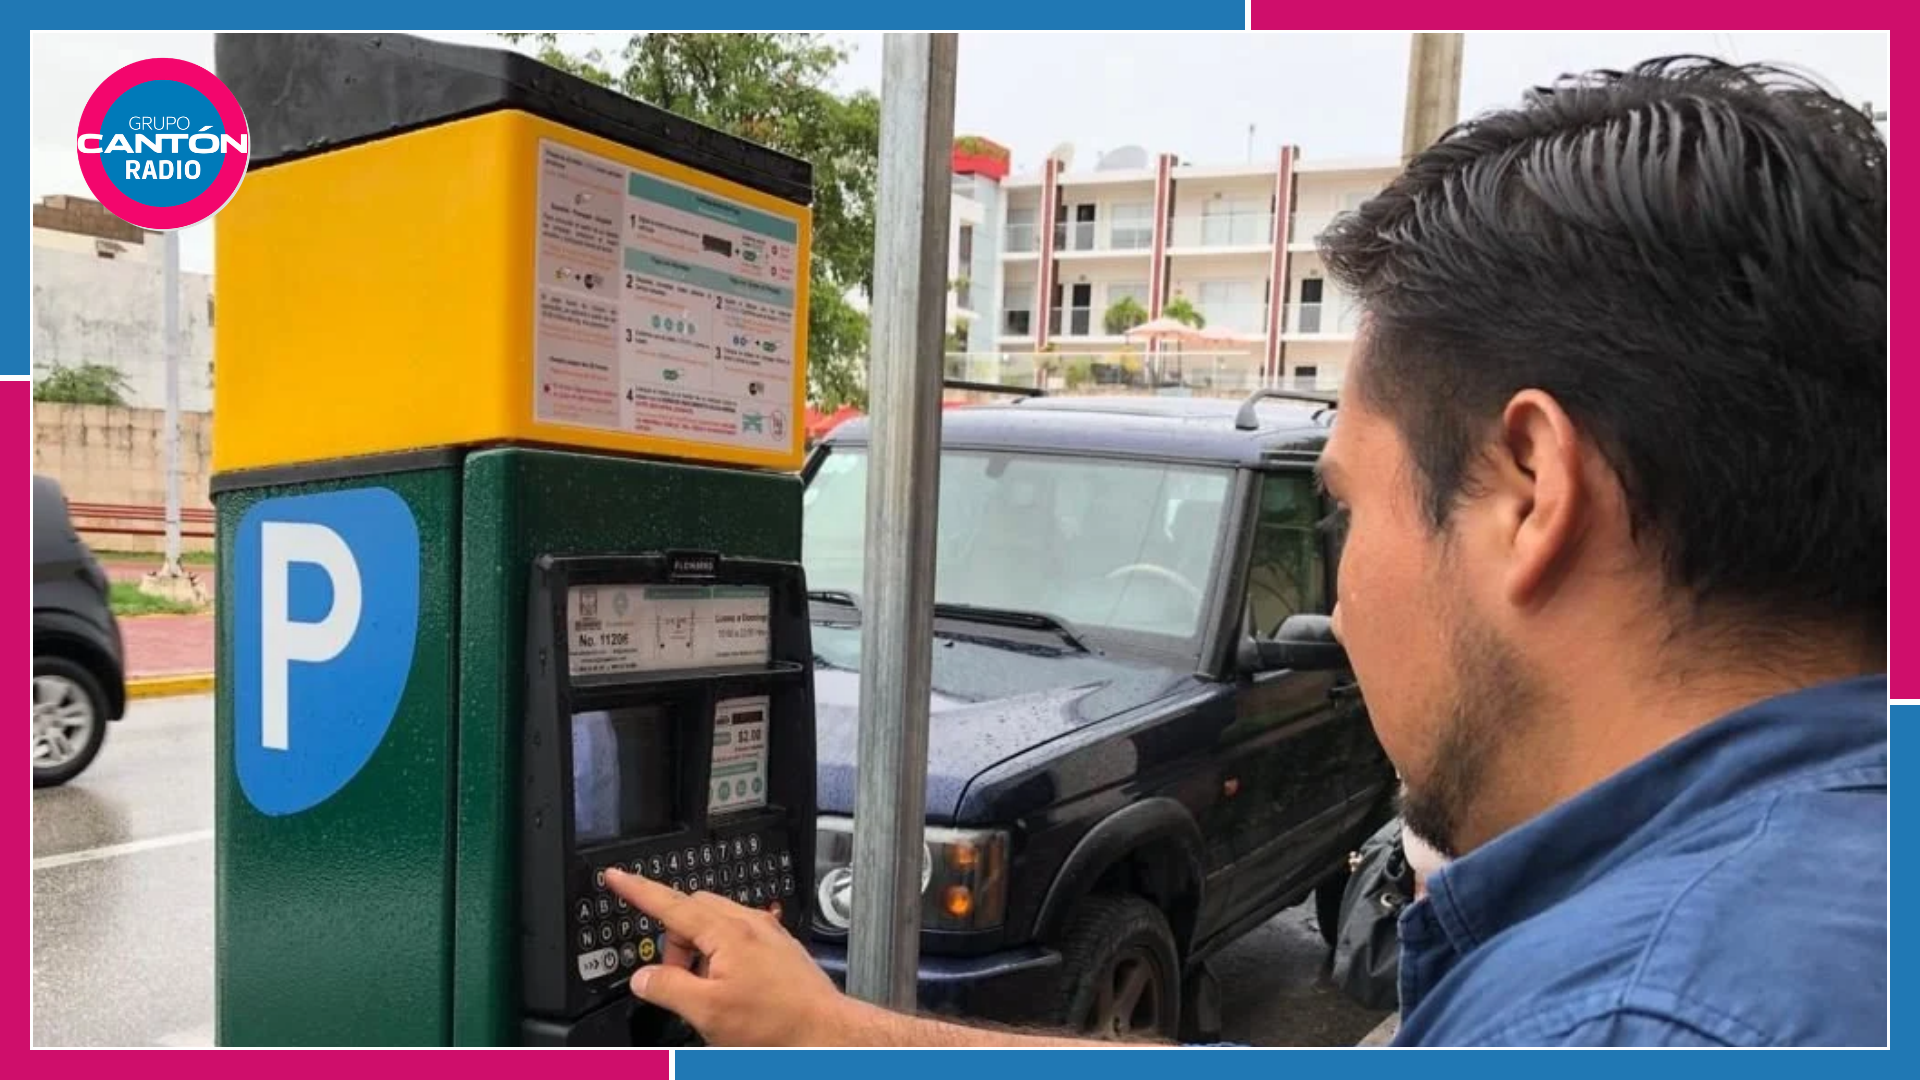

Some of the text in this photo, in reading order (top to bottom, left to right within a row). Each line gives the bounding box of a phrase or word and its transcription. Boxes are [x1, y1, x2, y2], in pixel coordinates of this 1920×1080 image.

[629, 215, 636, 229] 1
[625, 274, 634, 289] 2
[716, 296, 723, 310] 2
[625, 329, 633, 343] 3
[715, 346, 722, 360] 3
[625, 387, 634, 402] 4
[260, 521, 363, 752] P
[579, 634, 595, 647] No.
[635, 863, 642, 875] 2
[653, 859, 660, 874] 3
[670, 855, 678, 869] 4
[687, 851, 695, 866] 5
[703, 848, 711, 862] 6
[719, 844, 726, 858] 7
[735, 840, 742, 854] 8
[749, 838, 757, 852] 9
[580, 904, 589, 918] A
[600, 900, 609, 912] B
[689, 879, 698, 890] G
[706, 875, 714, 885] H
[738, 866, 744, 878] J
[753, 862, 760, 873] K
[768, 860, 774, 870] L
[781, 855, 791, 866] M
[582, 932, 592, 945] N
[622, 921, 630, 935] P
[640, 916, 649, 930] Q
[785, 878, 791, 890] Z
